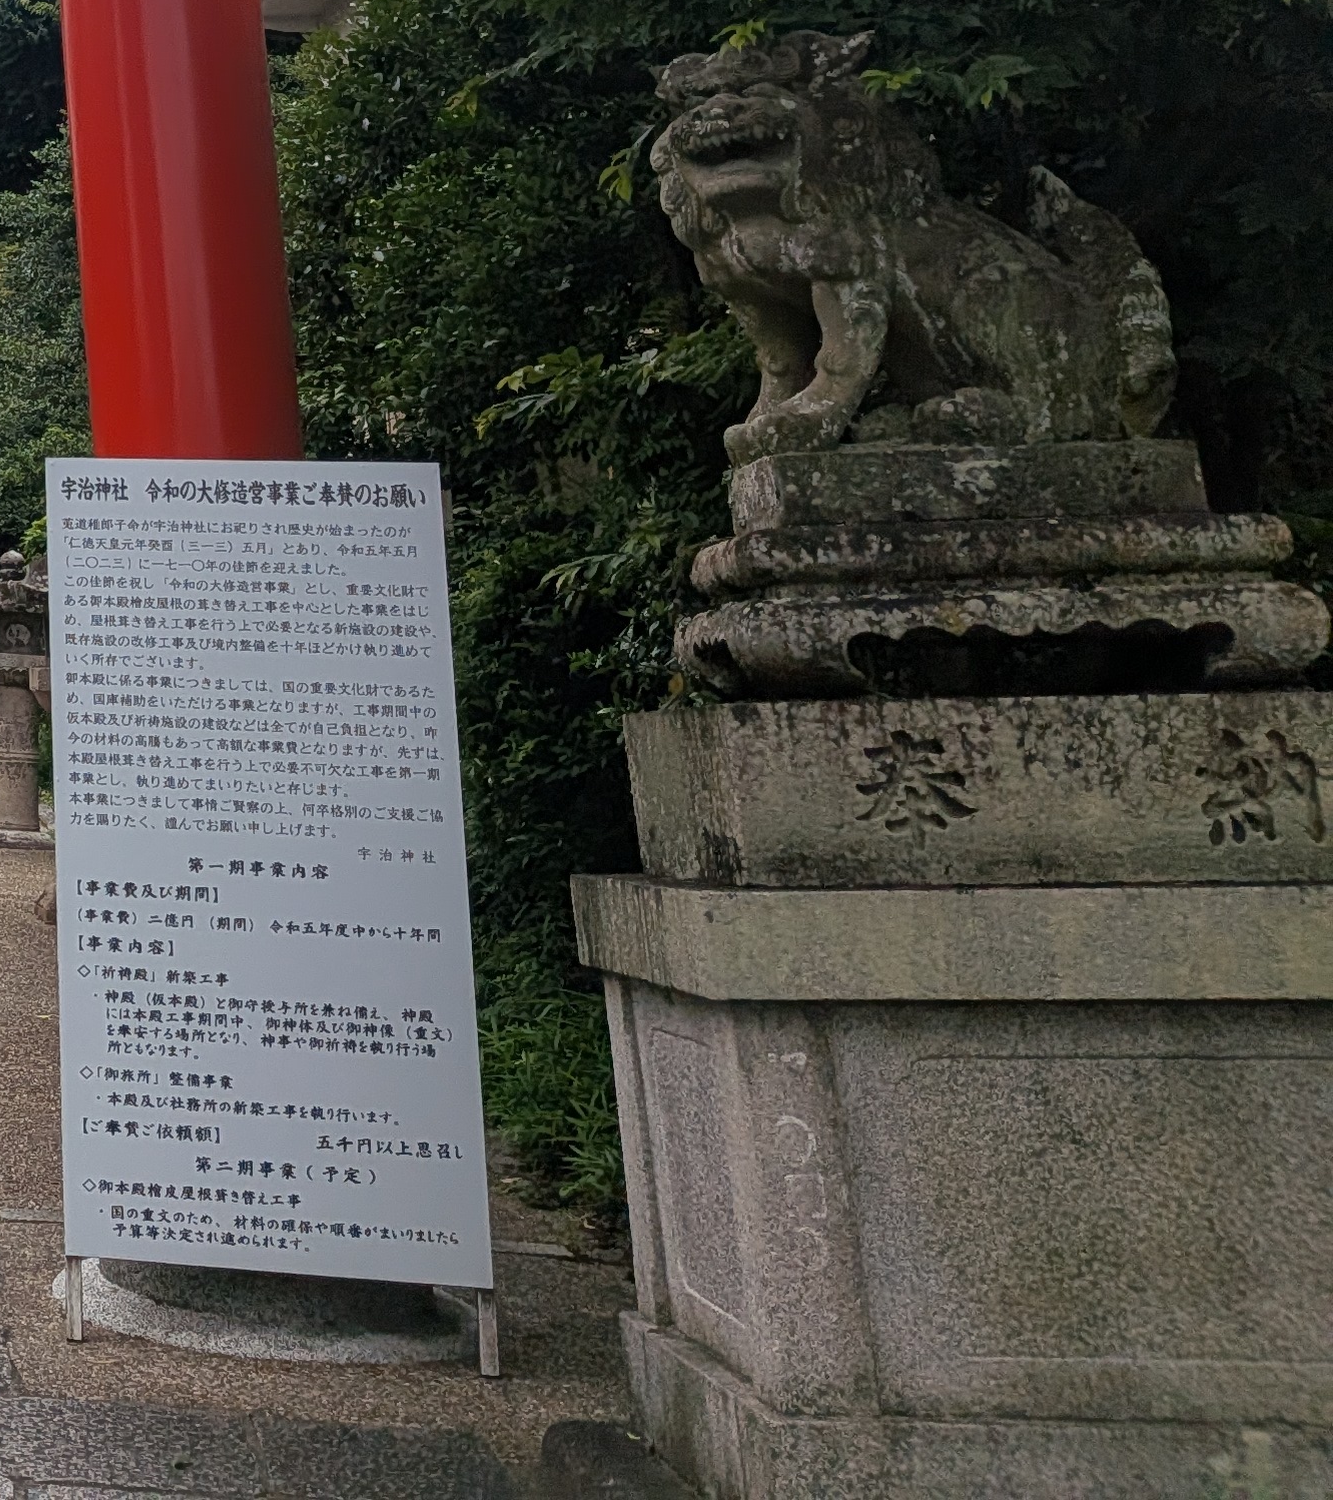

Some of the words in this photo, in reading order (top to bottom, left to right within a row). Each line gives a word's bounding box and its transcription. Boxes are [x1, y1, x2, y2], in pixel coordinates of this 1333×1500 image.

[60, 476, 130, 502] 宇治神社
[144, 478, 426, 509] 令和の大修造営事業ご奉賛のお願い
[65, 652, 204, 671] いく所存でございます。
[188, 856, 329, 880] 第一期事業内容
[76, 879, 219, 904] 【事業費及び期間】
[78, 934, 174, 957] 【事業内容】
[107, 1040, 199, 1060] 所ともなります。
[82, 1117, 221, 1145] 【ご奉賛ご依頼額】
[315, 1134, 464, 1160] 五千円以上思召し
[112, 1222, 310, 1253] 予算等決定され進められます。
